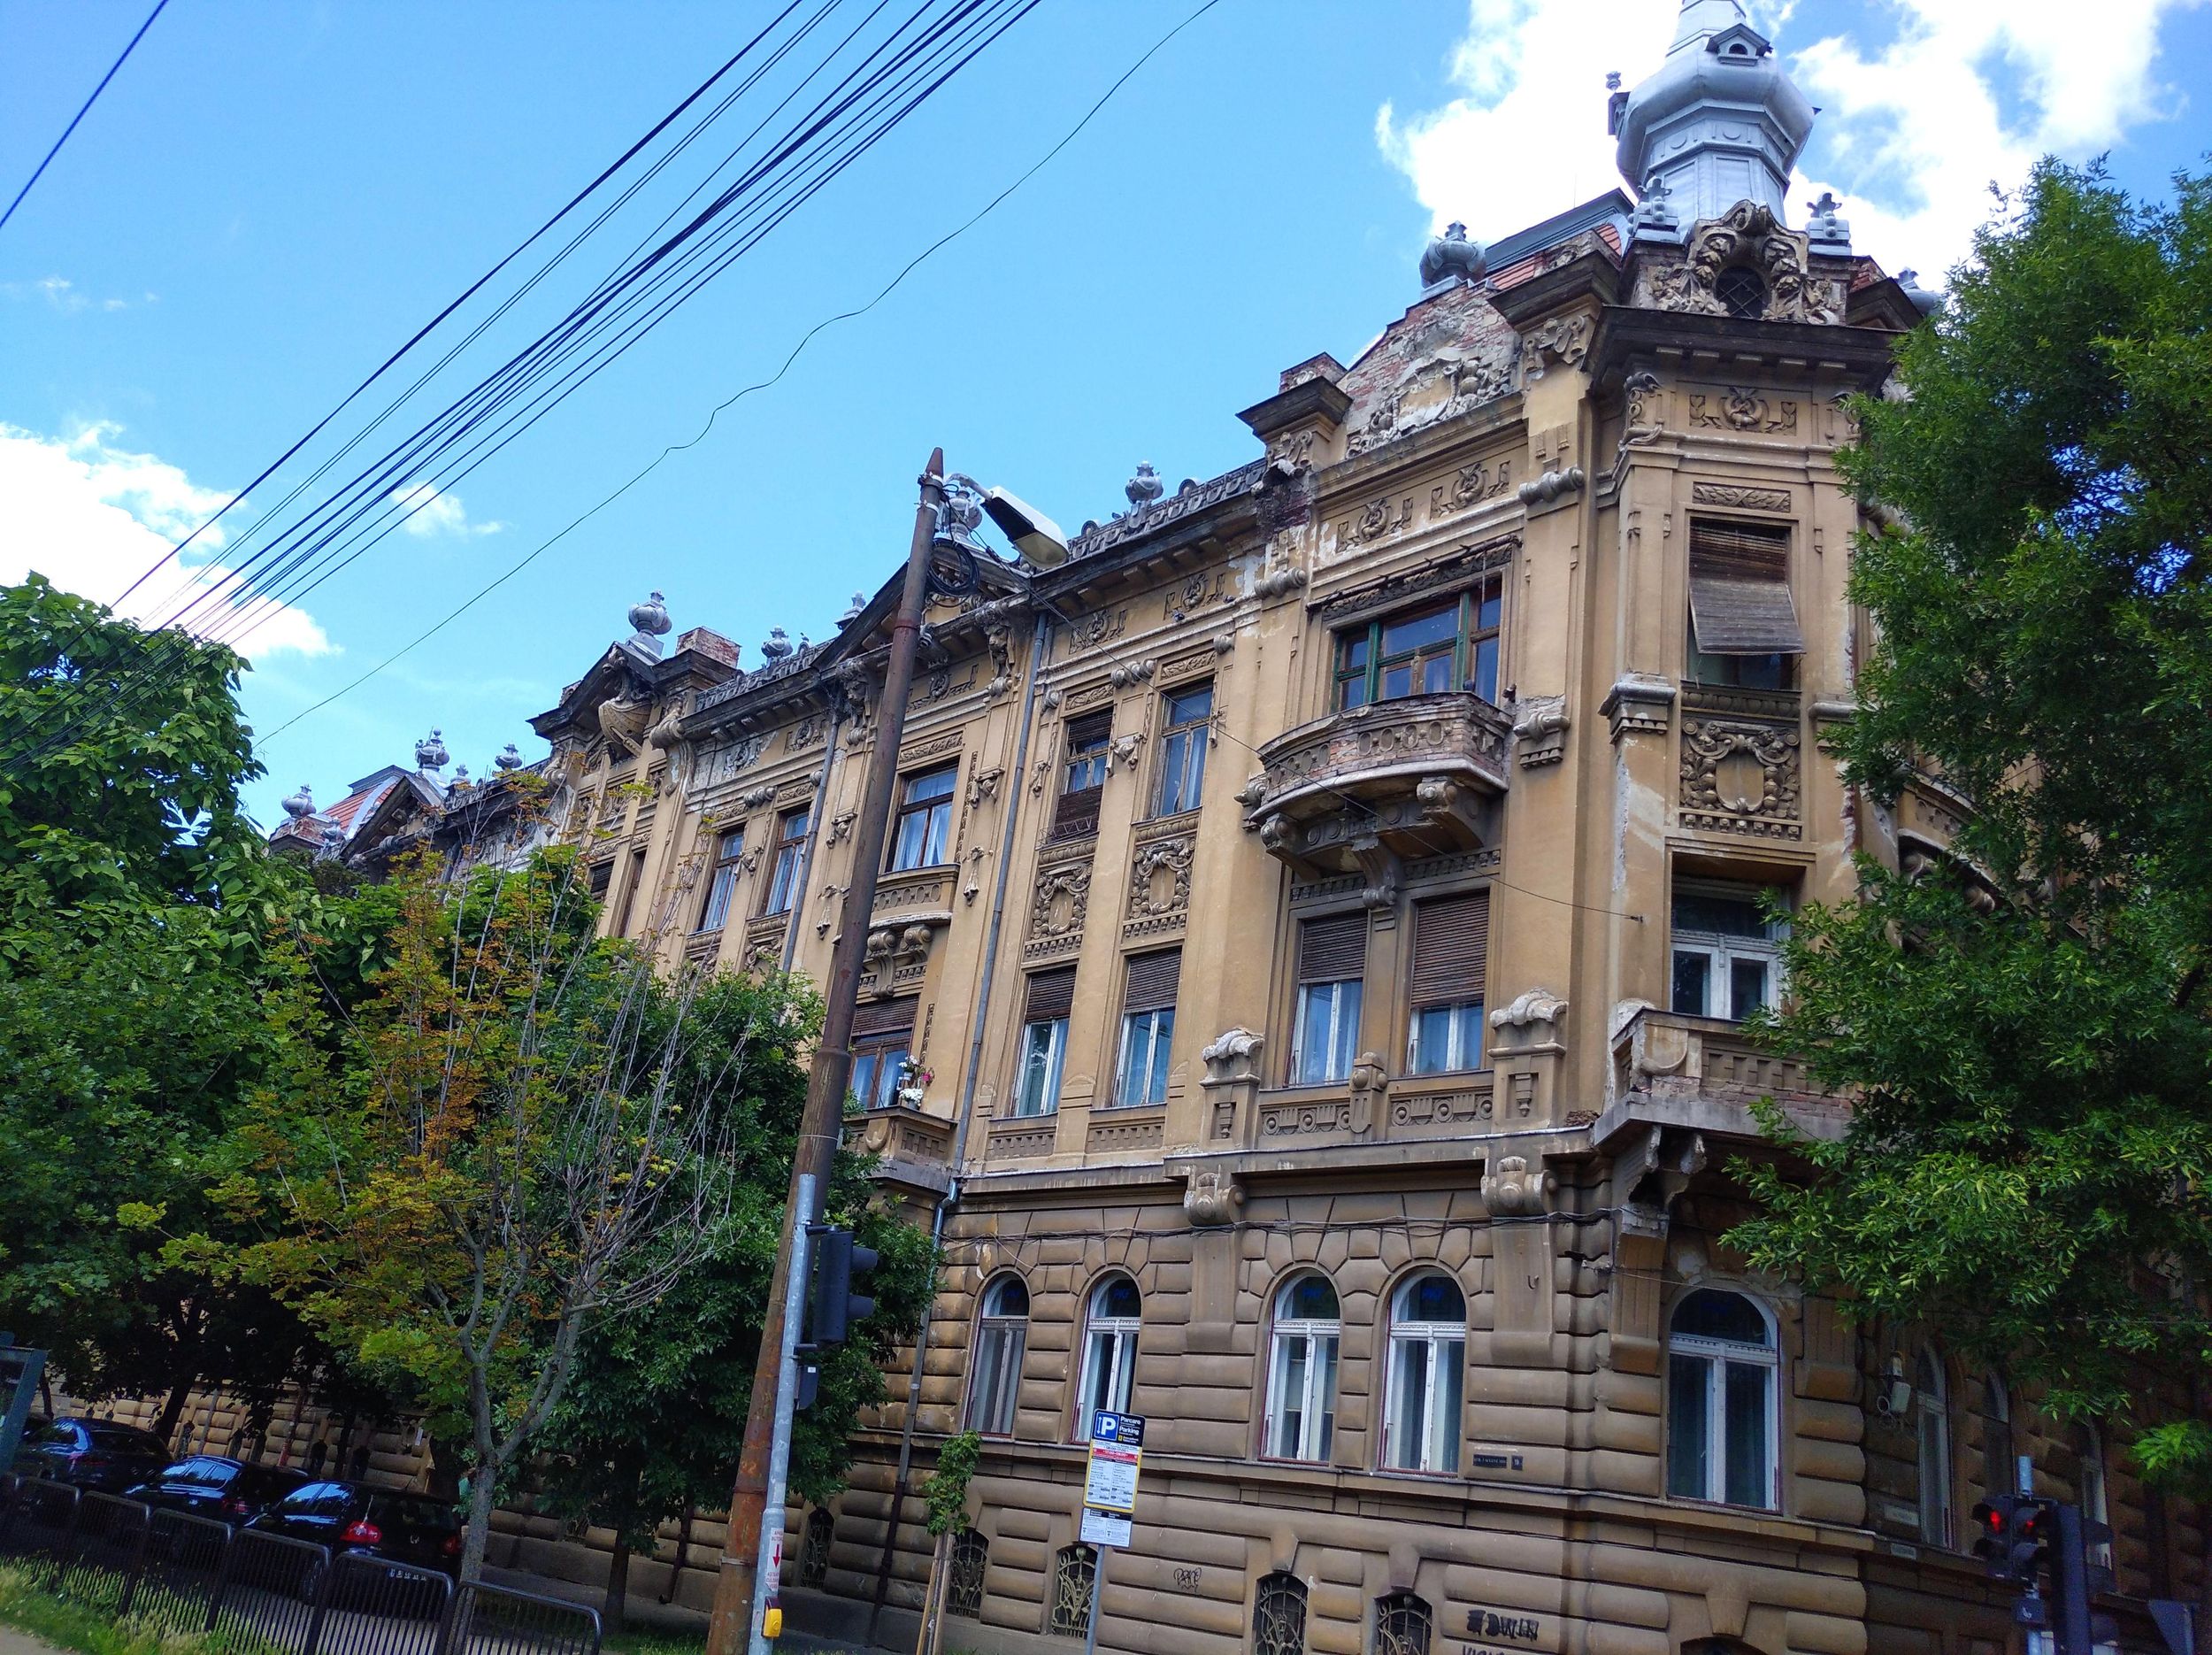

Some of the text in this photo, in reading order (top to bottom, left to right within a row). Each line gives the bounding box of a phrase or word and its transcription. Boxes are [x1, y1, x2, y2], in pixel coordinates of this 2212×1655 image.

[1101, 1416, 1117, 1436] P
[1120, 1415, 1141, 1426] Parcare
[1118, 1426, 1140, 1436] Parking
